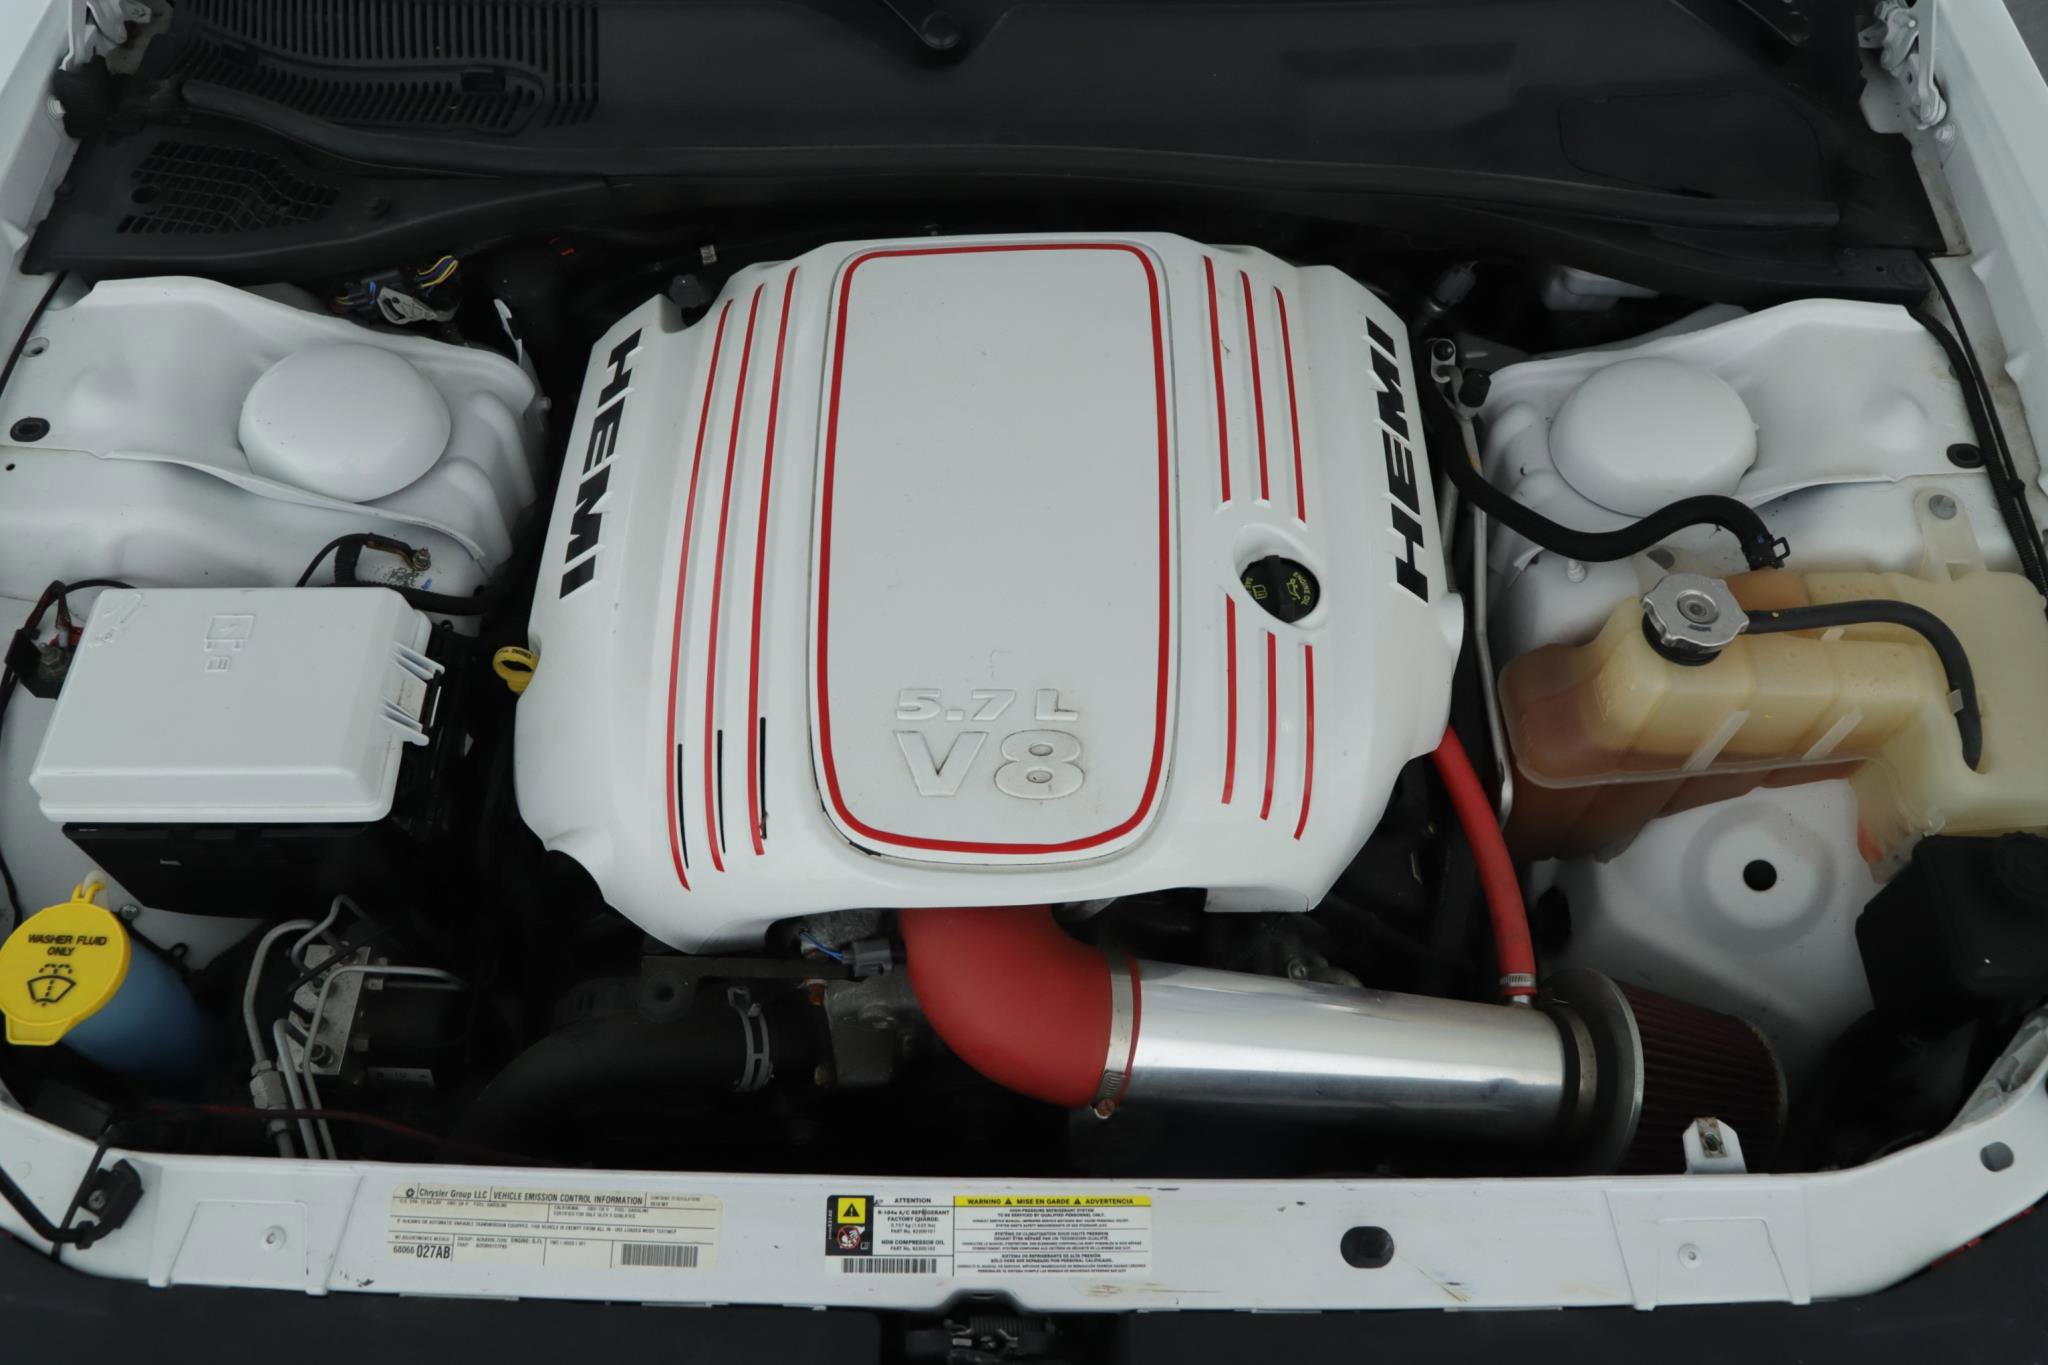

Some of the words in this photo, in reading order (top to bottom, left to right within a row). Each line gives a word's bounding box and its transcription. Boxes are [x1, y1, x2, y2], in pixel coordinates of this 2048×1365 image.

[558, 327, 643, 600] HEMI
[1364, 316, 1428, 605] HEMI
[893, 728, 1085, 801] V8
[28, 934, 73, 944] WASHER
[76, 935, 108, 945] FLUID
[47, 947, 76, 956] ONLY
[420, 1188, 449, 1198] Chrysler
[450, 1189, 472, 1199] Group
[474, 1190, 488, 1199] LLC
[493, 1191, 522, 1200] VEHICLE
[524, 1192, 558, 1202] EMISSION
[560, 1194, 591, 1204] CONTROL
[595, 1195, 643, 1205] INFORMATION
[393, 1245, 415, 1254] 68066
[416, 1245, 451, 1259] 027AB
